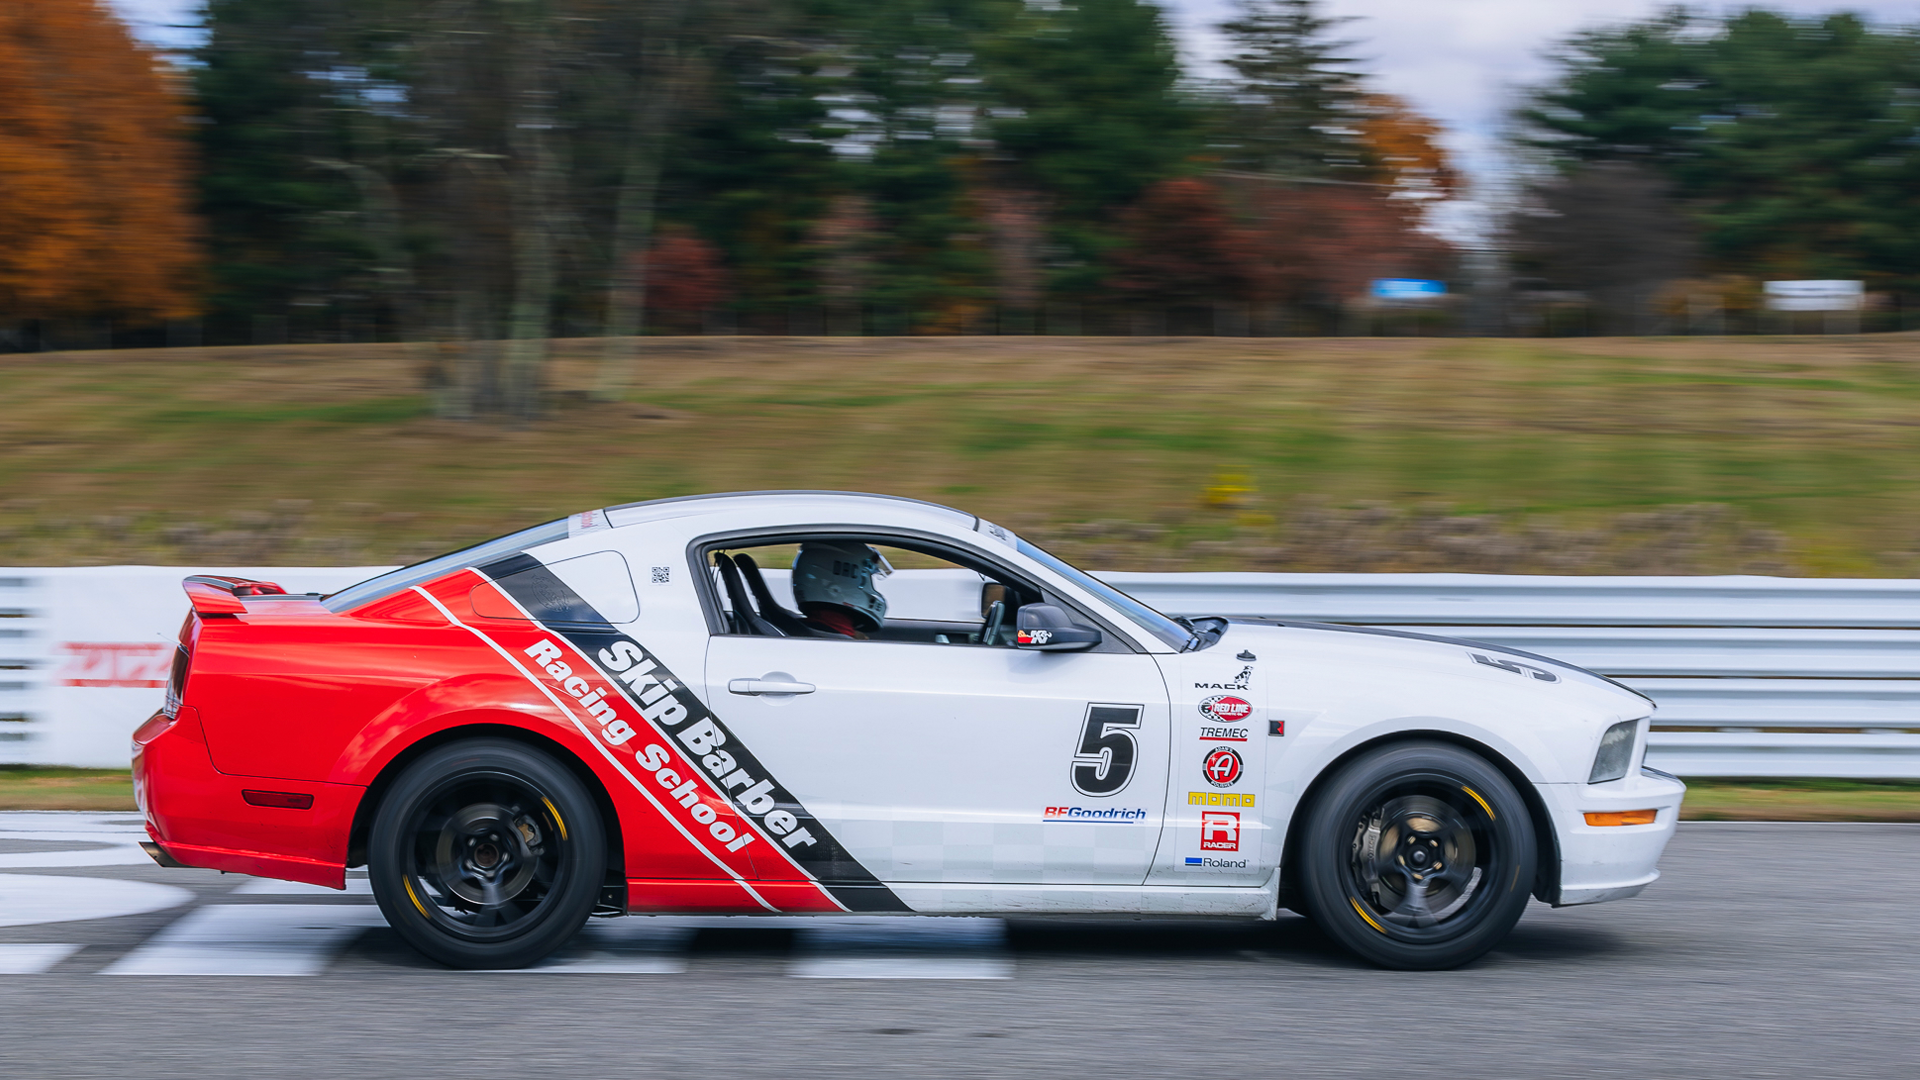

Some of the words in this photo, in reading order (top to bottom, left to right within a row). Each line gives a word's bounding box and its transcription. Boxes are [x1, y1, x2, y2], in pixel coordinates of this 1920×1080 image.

[1465, 651, 1562, 684] 5
[1213, 703, 1230, 713] RED
[1231, 703, 1249, 714] LINE
[1201, 727, 1248, 738] TREMEC
[524, 638, 637, 746] Racing
[635, 743, 755, 853] School
[598, 641, 688, 726] Skip
[676, 716, 817, 849] Barber
[1069, 701, 1145, 798] 5
[1044, 806, 1147, 820] BFGoodrich
[1203, 841, 1237, 849] RACER
[1203, 857, 1247, 868] Roland
